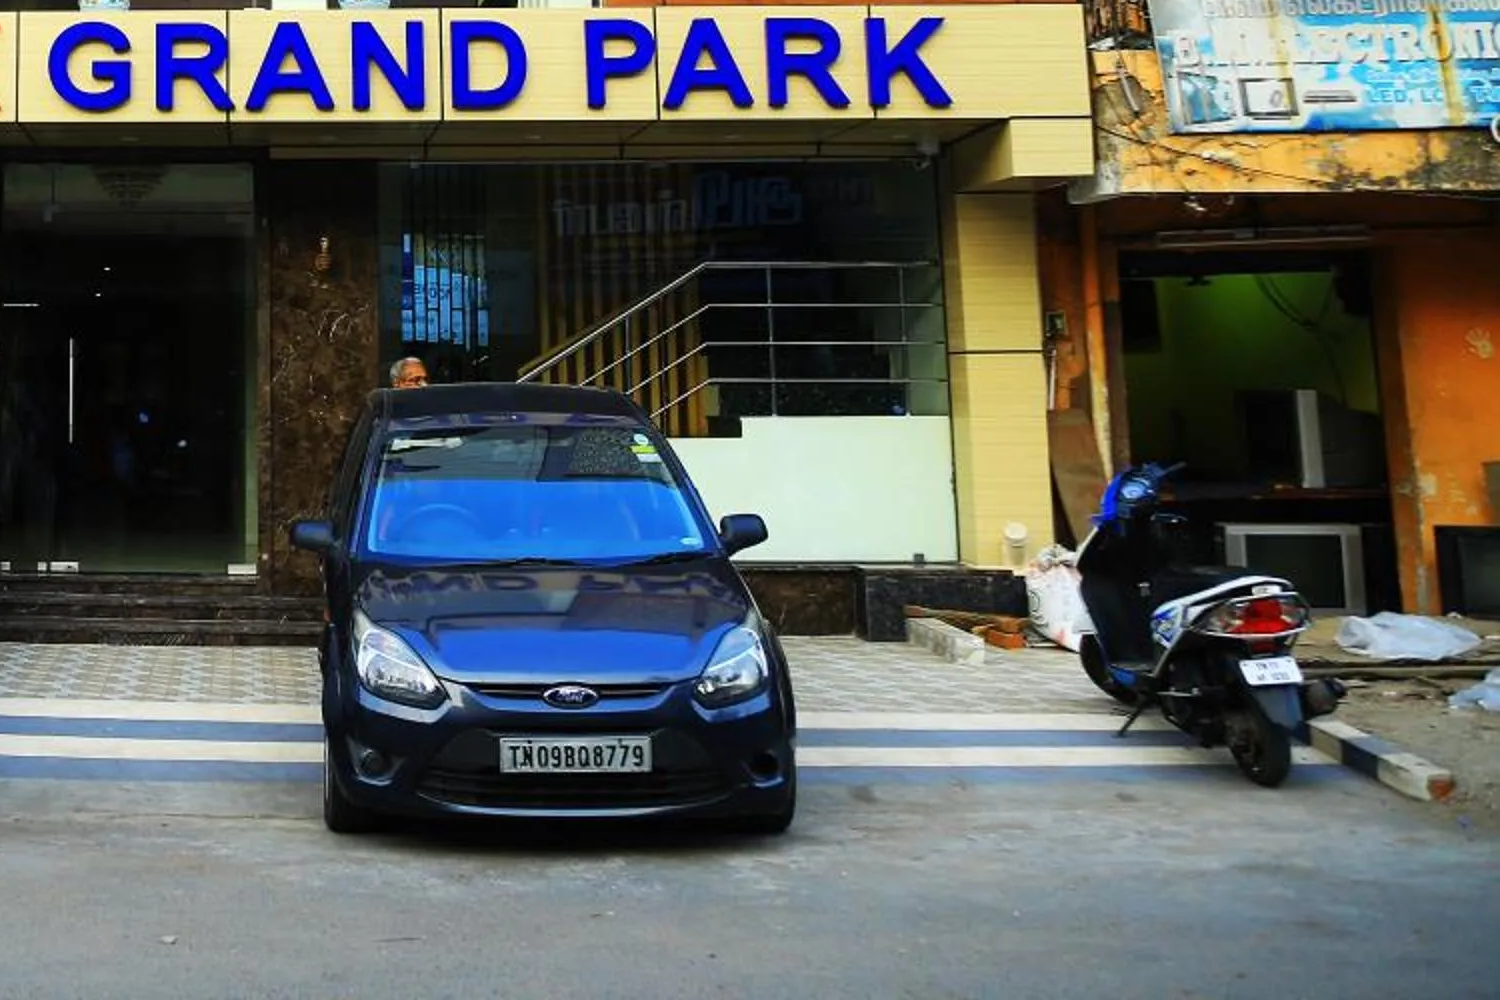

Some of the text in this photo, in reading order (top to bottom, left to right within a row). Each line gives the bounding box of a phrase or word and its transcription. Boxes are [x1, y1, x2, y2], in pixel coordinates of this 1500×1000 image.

[47, 19, 529, 112] GRAND
[584, 16, 954, 111] PARK
[508, 745, 645, 769] TN09BQ8779
